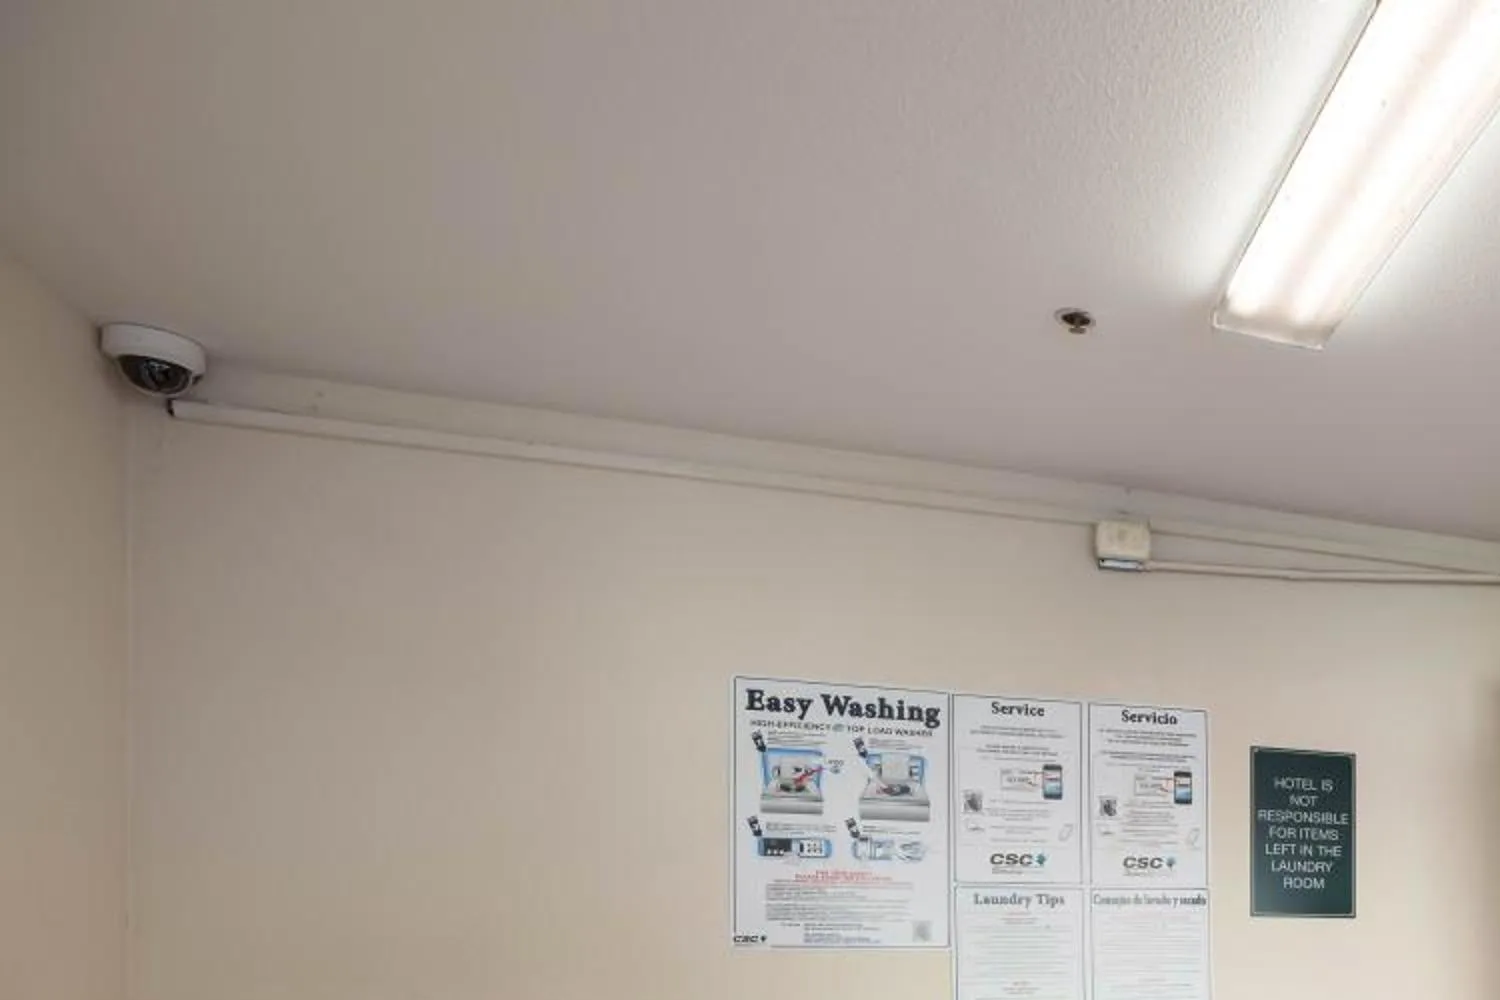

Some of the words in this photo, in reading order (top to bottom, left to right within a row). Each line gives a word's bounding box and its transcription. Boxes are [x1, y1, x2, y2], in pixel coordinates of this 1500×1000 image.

[746, 688, 813, 720] Easy
[820, 694, 940, 728] Washing
[991, 702, 1044, 717] Service
[1121, 710, 1177, 725] Servicio
[1274, 777, 1318, 791] HOTEL
[1321, 780, 1333, 792] IS
[1290, 795, 1318, 807] NOT
[1257, 809, 1349, 825] RESPONSIBLE
[1269, 826, 1297, 839] FOR
[1300, 828, 1339, 841] ITEMS
[1265, 843, 1296, 855] LEFT
[1300, 845, 1313, 857] IN
[1317, 846, 1342, 857] THE
[989, 853, 1033, 866] CSC
[1123, 857, 1164, 869] CSC
[1271, 861, 1333, 873] LAUNDRY
[1283, 877, 1325, 889] ROOM
[974, 893, 1030, 908] Laundry
[1037, 894, 1065, 909] Tips
